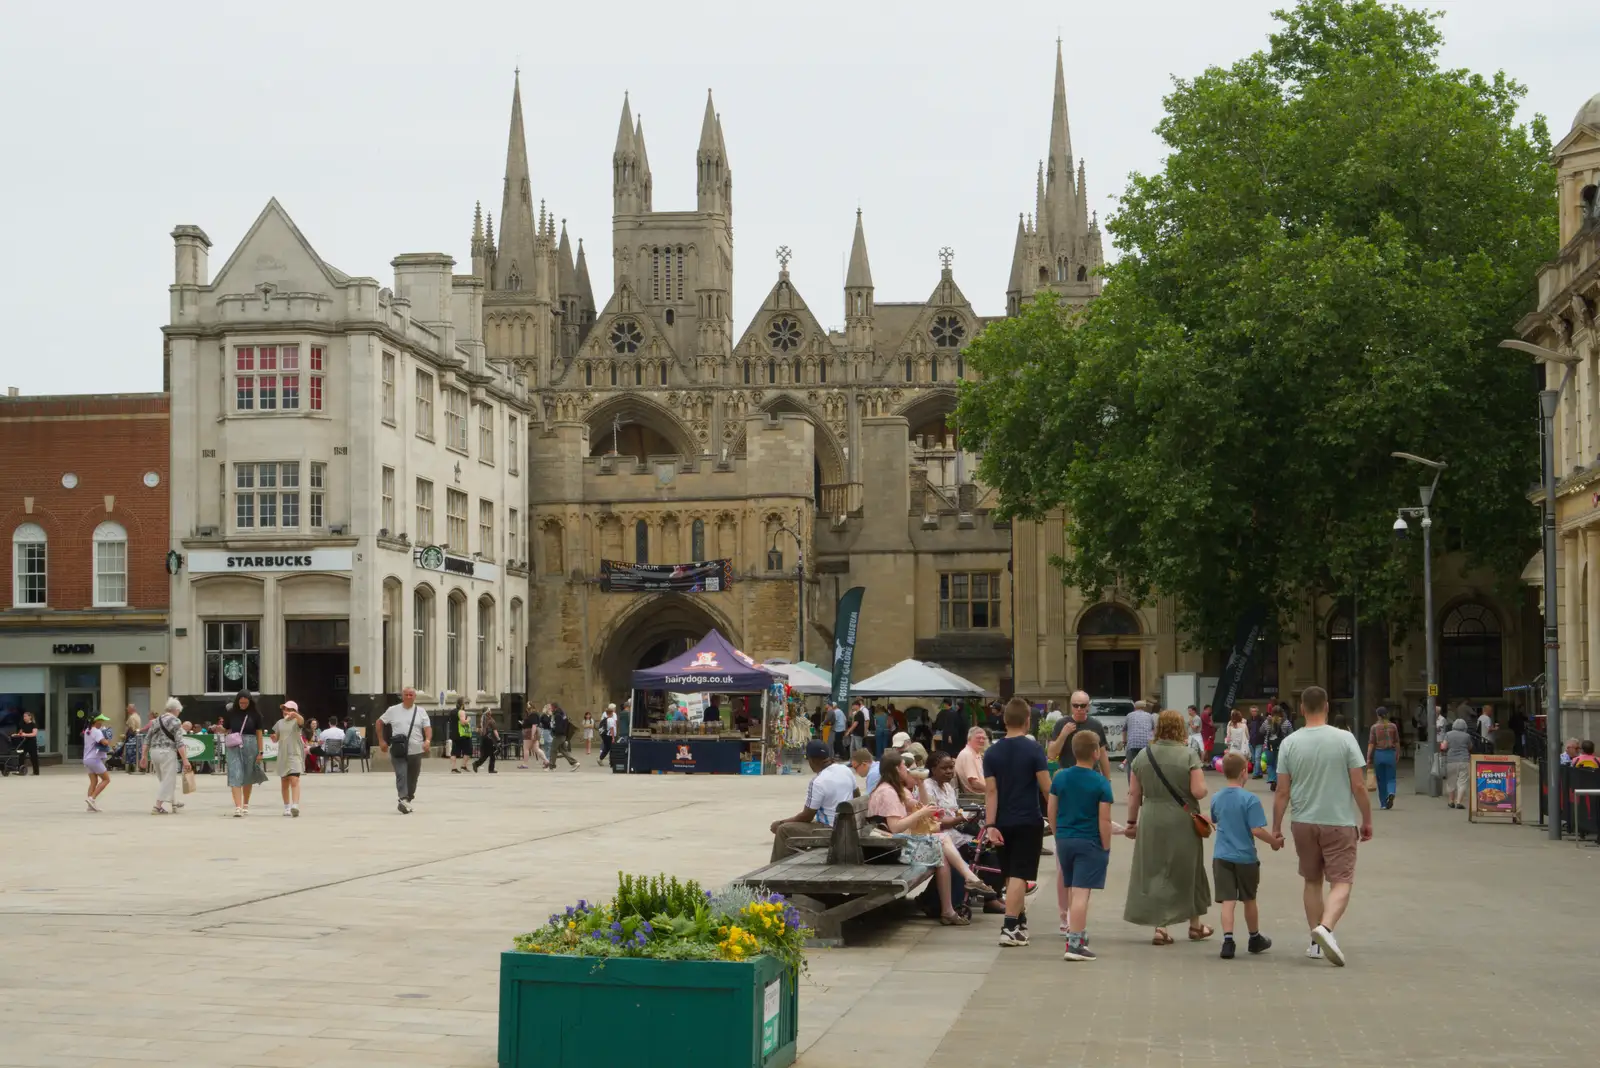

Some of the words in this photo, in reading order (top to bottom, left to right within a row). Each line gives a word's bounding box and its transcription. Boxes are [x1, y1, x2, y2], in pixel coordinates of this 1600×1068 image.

[227, 556, 312, 567] STARBUCKS
[847, 611, 858, 645] MUSEUM
[843, 646, 853, 675] GALORE
[665, 675, 733, 685] hairydogs.co.uk
[838, 676, 849, 702] FOSSILS
[1429, 686, 1437, 695] H
